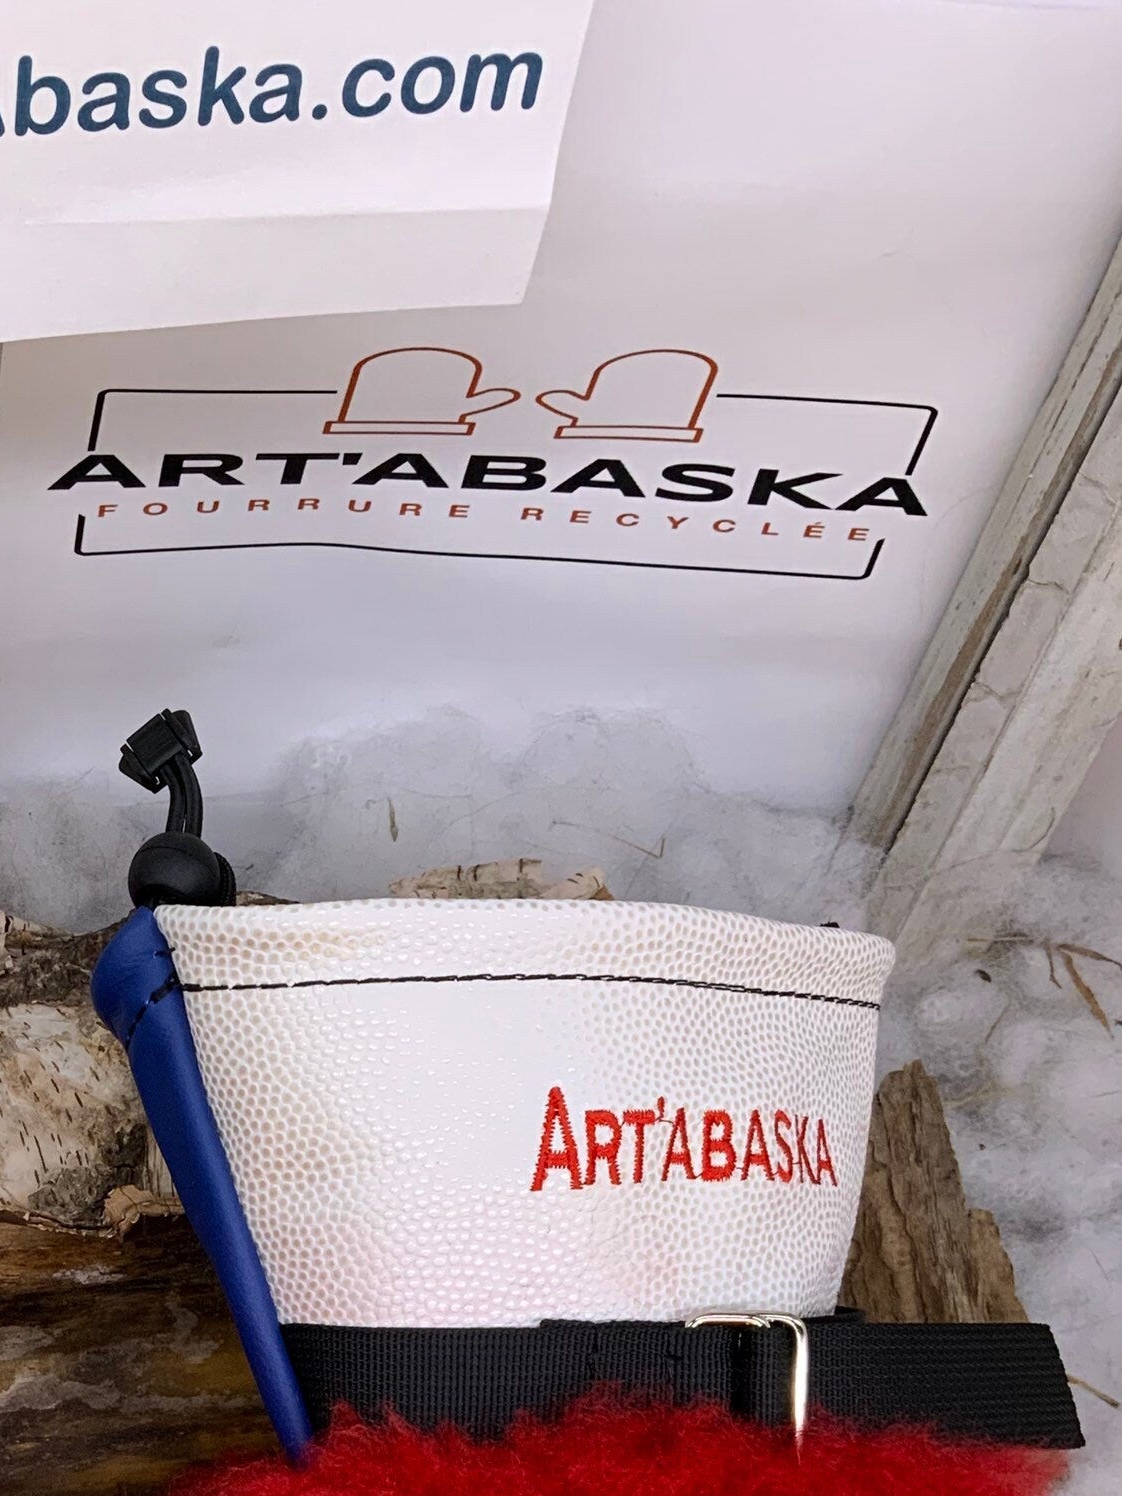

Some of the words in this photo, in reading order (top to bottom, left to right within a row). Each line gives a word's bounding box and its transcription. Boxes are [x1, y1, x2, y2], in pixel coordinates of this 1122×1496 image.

[47, 452, 928, 517] ART'ABASKA
[96, 496, 470, 519] FOURRURE
[520, 505, 870, 542] RECYCLÉE
